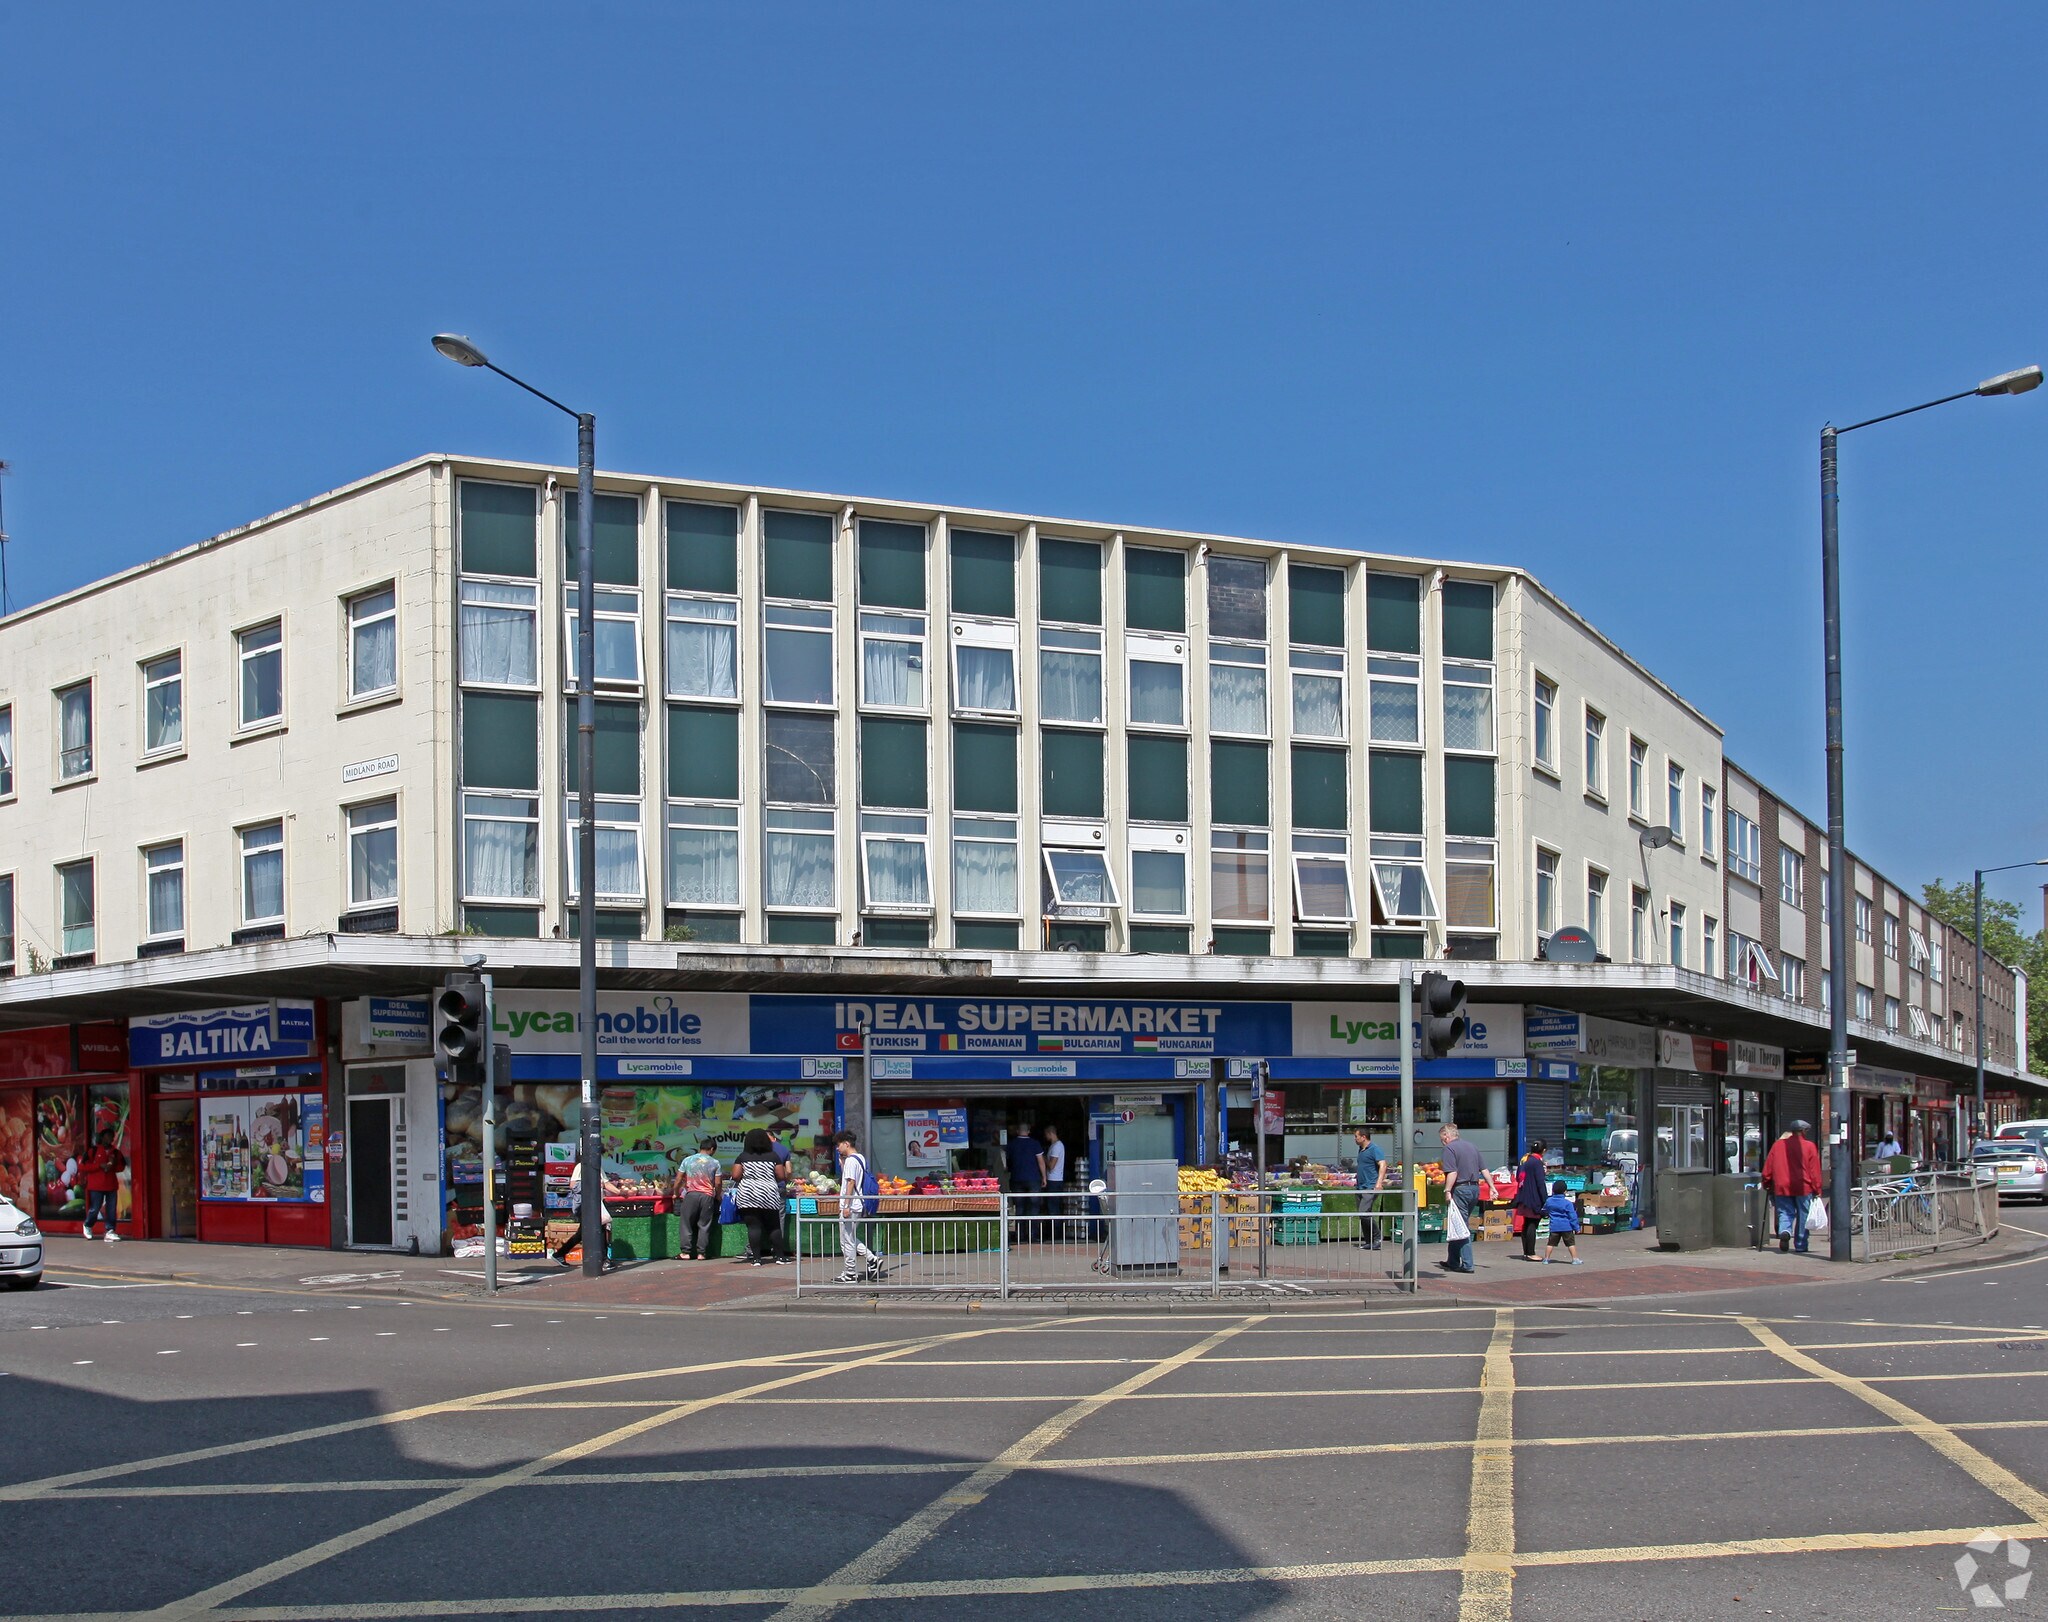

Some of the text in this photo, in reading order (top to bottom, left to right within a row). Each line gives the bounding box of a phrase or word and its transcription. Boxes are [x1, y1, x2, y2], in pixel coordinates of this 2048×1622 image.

[345, 759, 396, 778] MIDLAND ROAD
[388, 1001, 410, 1010] IDEAL
[178, 1014, 198, 1023] Latvian
[201, 1010, 227, 1023] Romanian
[231, 1010, 252, 1018] Russian
[372, 1009, 426, 1018] SUPERMARKET
[836, 1002, 1222, 1032] IDEAL SUPERMARKET
[1528, 1024, 1576, 1032] SUPERMARKET
[160, 1025, 271, 1058] BALTIKA
[598, 1035, 618, 1044] Call
[620, 1035, 636, 1044] the
[637, 1036, 665, 1044] world
[667, 1036, 681, 1044] for
[869, 1037, 919, 1047] TURKISH
[967, 1038, 1022, 1048] ROMANIAN
[1064, 1039, 1120, 1048] BULGARIAN
[1159, 1040, 1212, 1049] HUNGARIAN
[1737, 1044, 1781, 1070] Retail Therapy
[626, 1062, 684, 1072] Lycamobile
[817, 1060, 842, 1069] Lyca
[887, 1058, 911, 1069] Lyca
[1018, 1062, 1068, 1073] Lycamobile
[1188, 1061, 1210, 1070] Lyca
[1356, 1063, 1400, 1073] Lycamobile
[1507, 1061, 1526, 1070] Lyca
[923, 1130, 939, 1148] 2
[633, 1163, 659, 1174] IWISA
